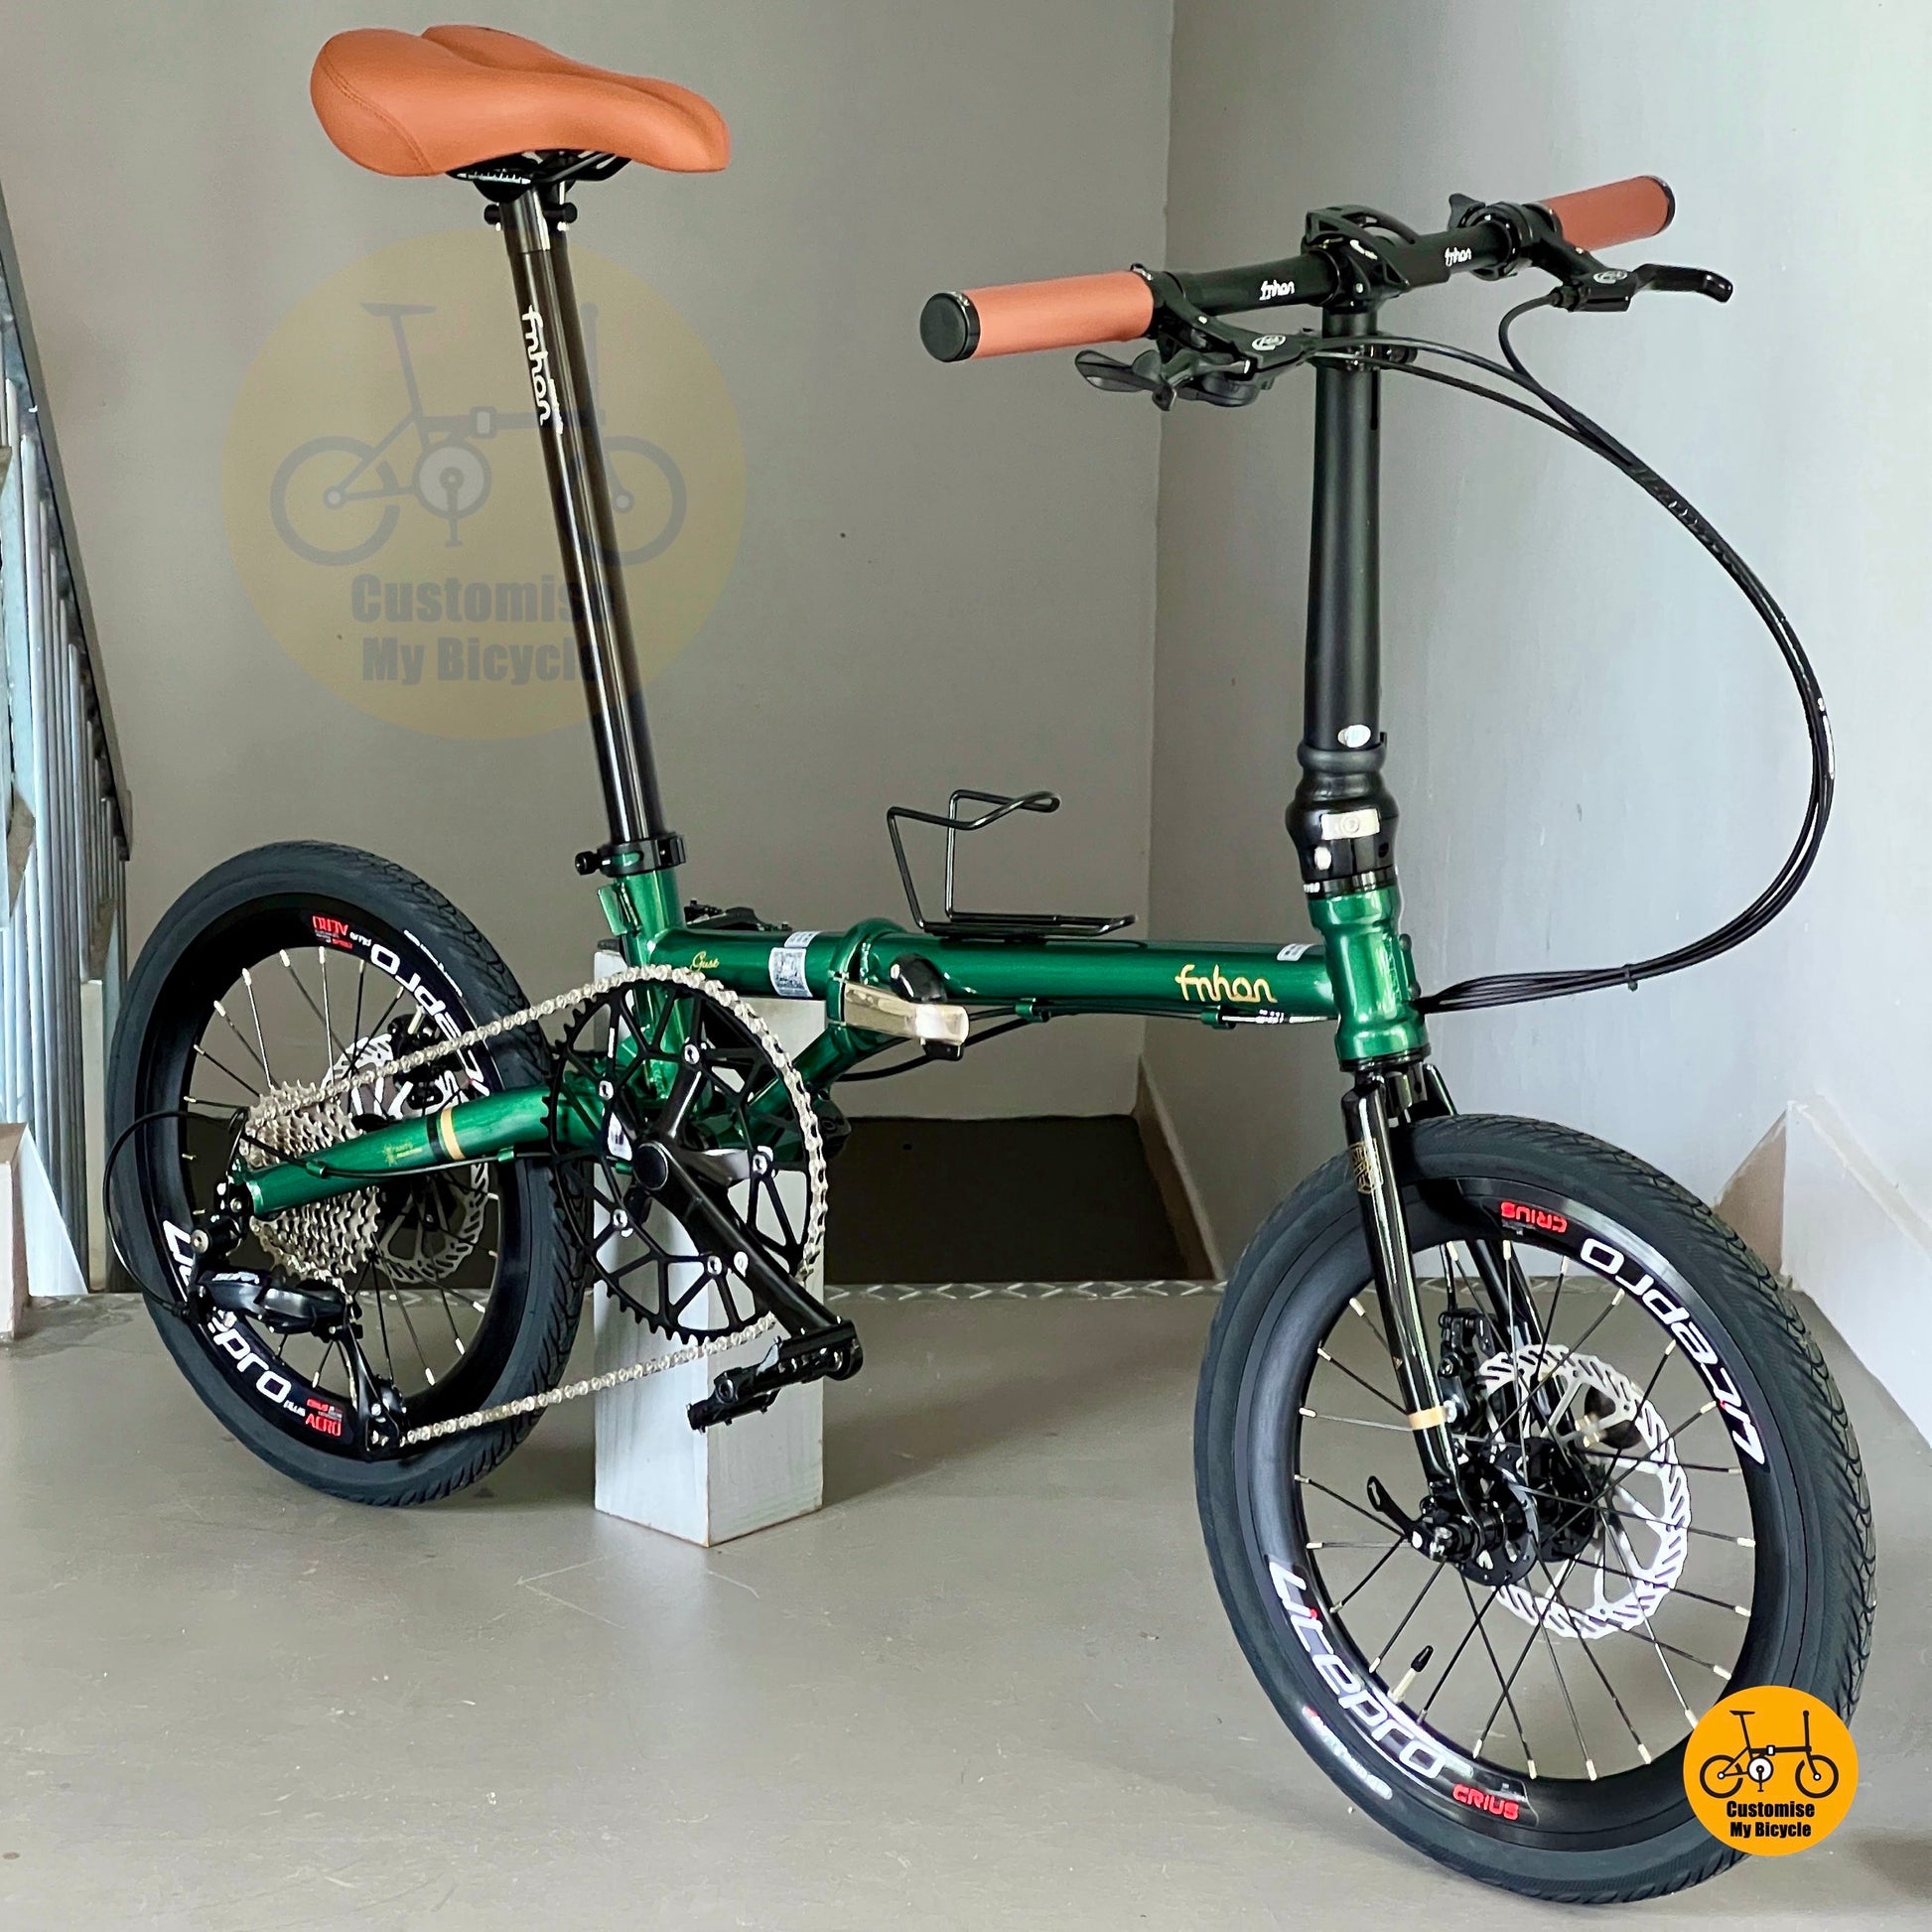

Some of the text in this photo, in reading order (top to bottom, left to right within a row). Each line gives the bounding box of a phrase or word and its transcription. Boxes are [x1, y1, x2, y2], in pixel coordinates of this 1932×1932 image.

[369, 943, 491, 1097] itepro
[1500, 1200, 1569, 1234] CRIUS
[1451, 1783, 1520, 1821] CRIUS
